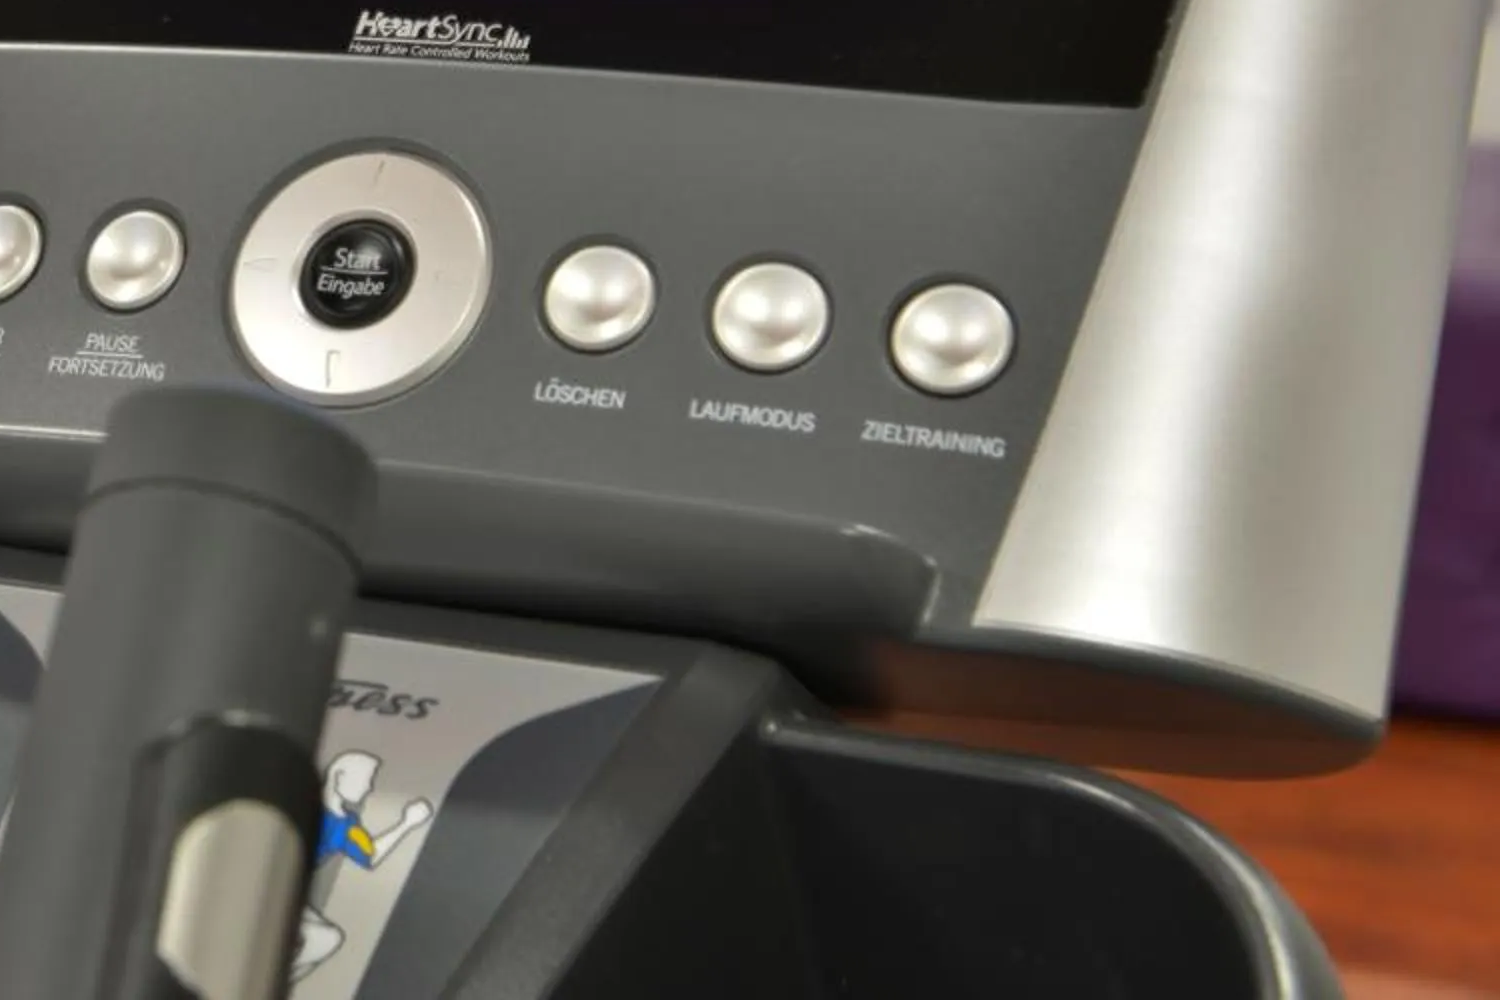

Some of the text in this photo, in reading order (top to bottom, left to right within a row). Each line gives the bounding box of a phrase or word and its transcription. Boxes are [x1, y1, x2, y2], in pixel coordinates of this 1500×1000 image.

[355, 10, 503, 43] HeartSync
[349, 43, 529, 62] Heart Rate Controlled Workouts
[335, 247, 382, 270] Start
[317, 273, 385, 299] Eingabe
[85, 332, 140, 353] PAUSE
[48, 356, 165, 382] FORTSETZUNG
[534, 377, 627, 409] LÖSCHEN
[689, 399, 817, 433] LAUFMODUS
[861, 419, 1006, 459] ZIELTRAINING
[326, 679, 440, 720] ness
